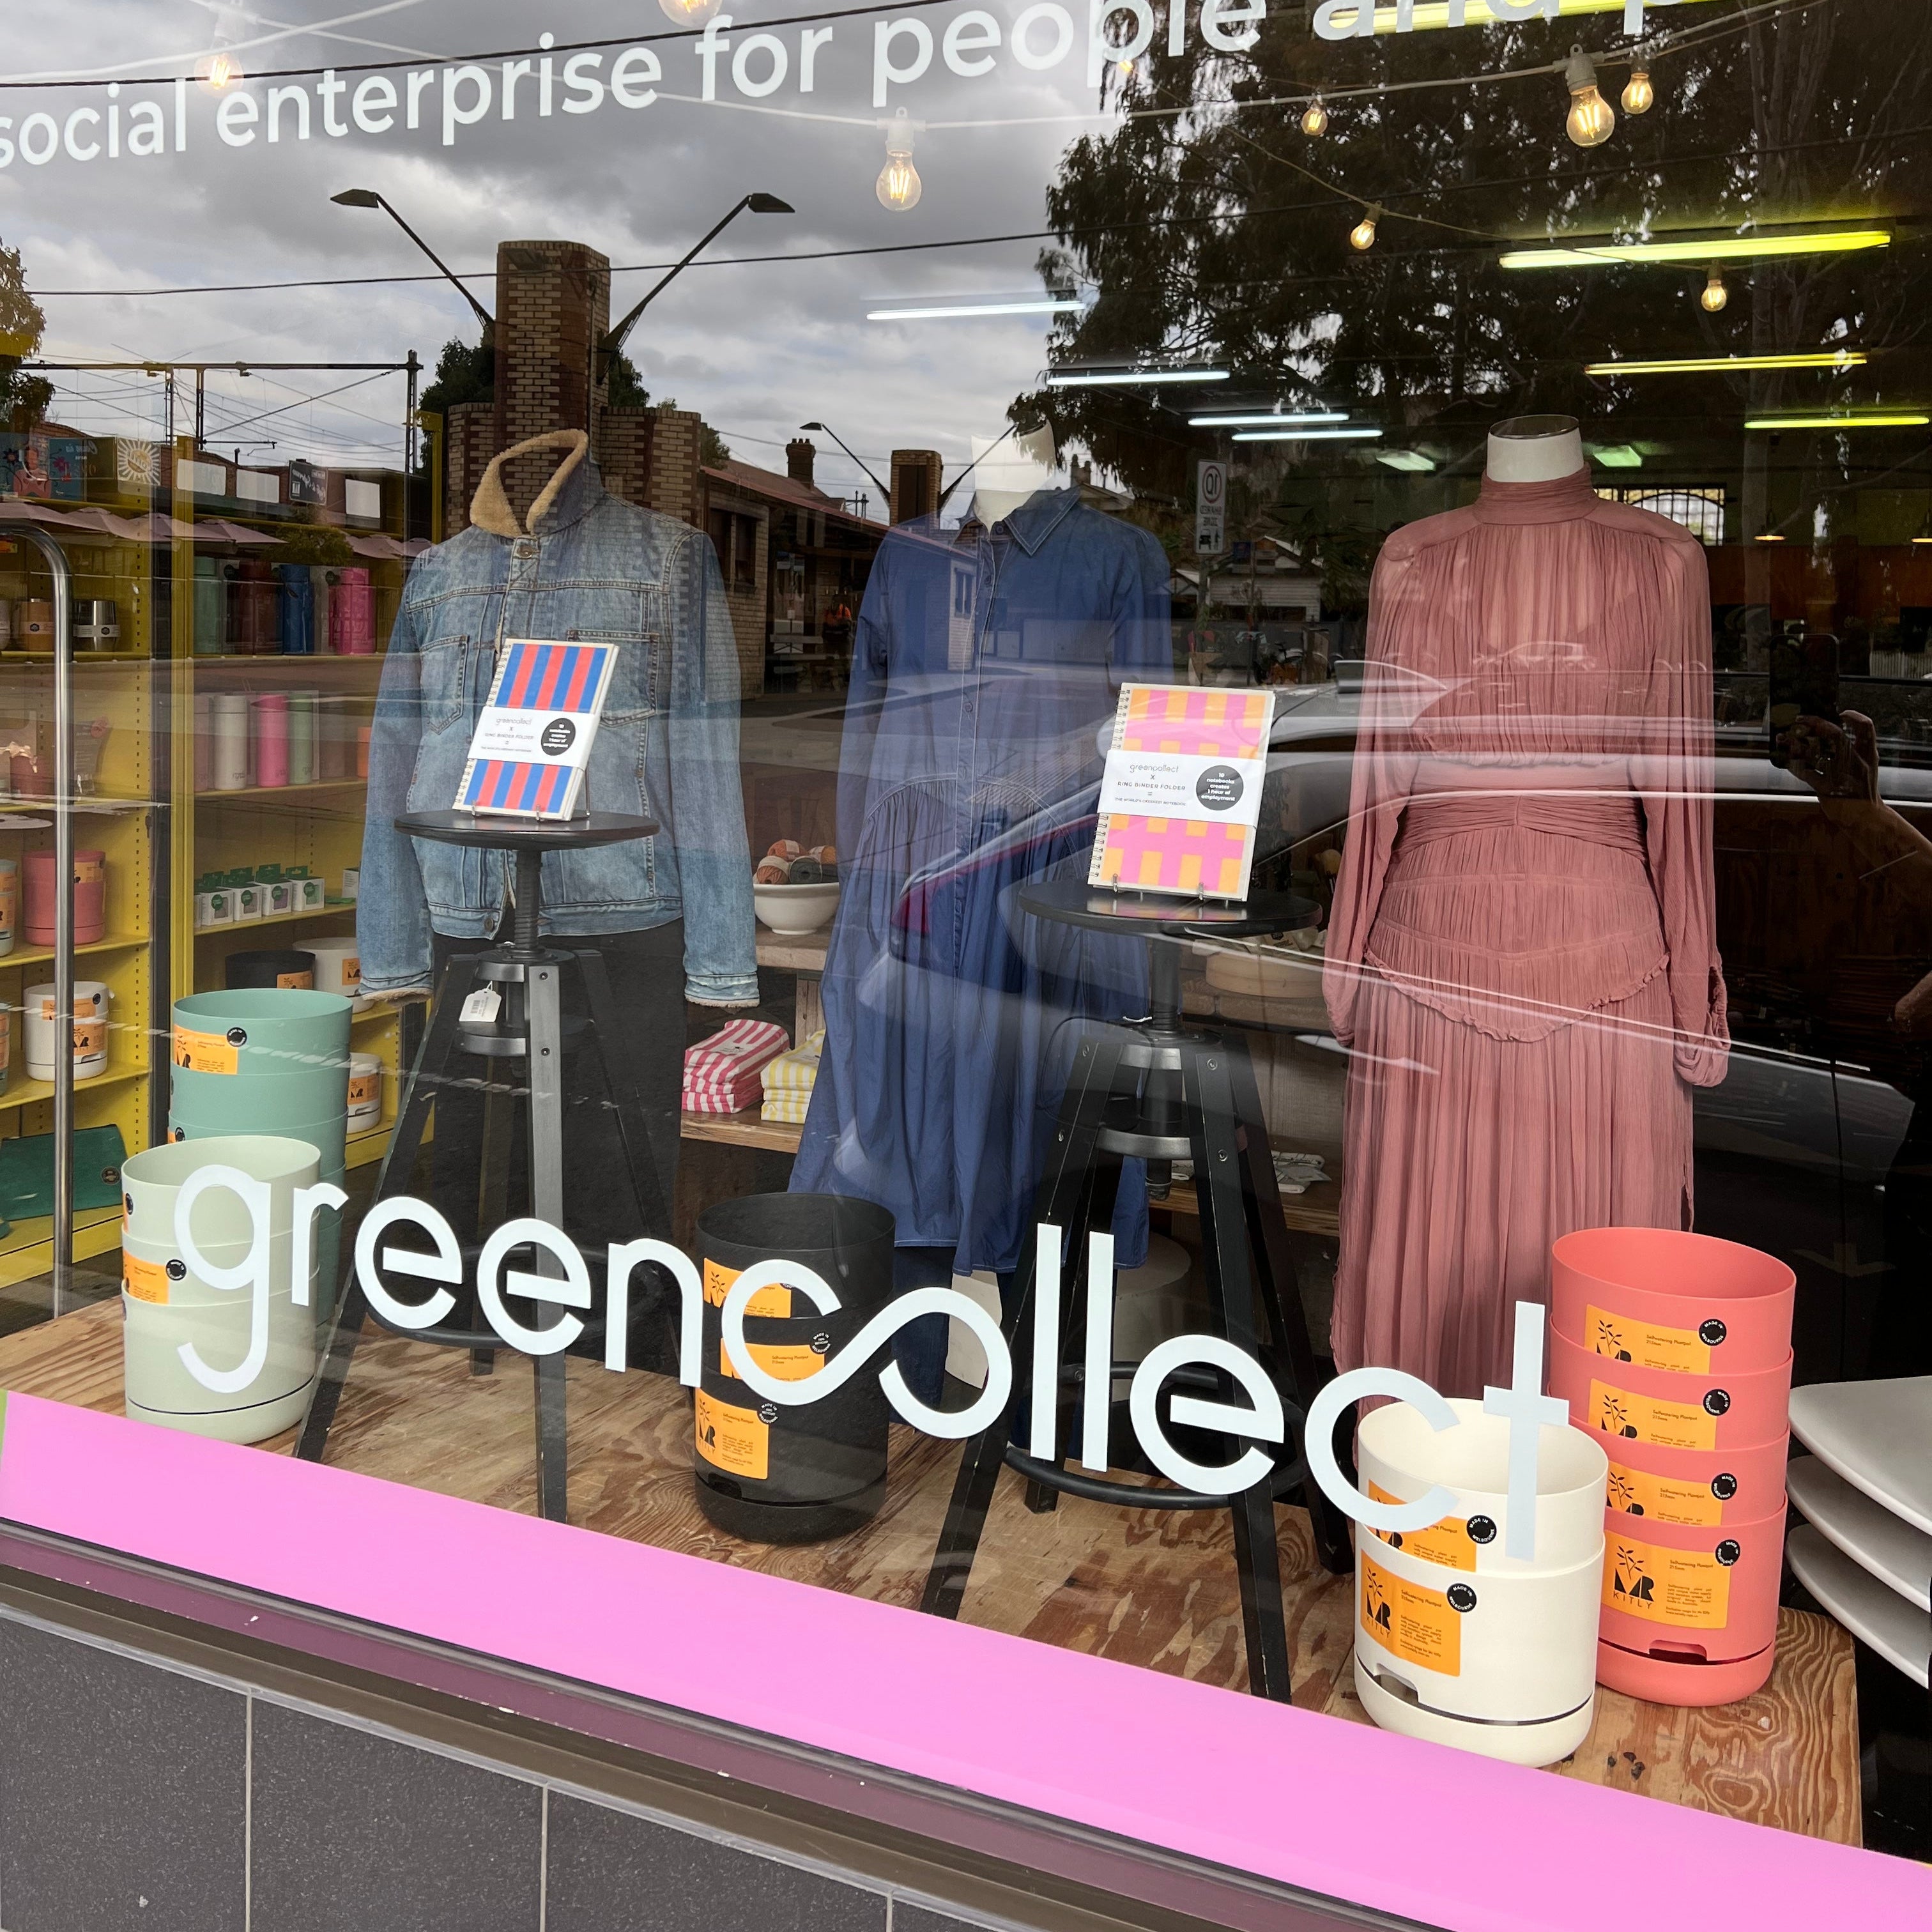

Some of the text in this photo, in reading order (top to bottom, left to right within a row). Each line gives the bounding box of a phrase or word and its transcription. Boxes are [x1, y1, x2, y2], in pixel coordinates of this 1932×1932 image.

[217, 32, 662, 147] enterprise
[695, 14, 832, 102] for
[873, 0, 1266, 108] people
[1130, 764, 1179, 773] greencollect
[1646, 1334, 1673, 1344] Selfwatering
[1701, 1333, 1724, 1344] MELBOURNE
[174, 1165, 1571, 1560] greencollect
[1652, 1409, 1678, 1420] Selfwatering
[1660, 1487, 1686, 1498] Selfwatering
[1469, 1517, 1481, 1528] MADE
[1613, 1591, 1653, 1609] KITLY
[1366, 1616, 1392, 1638] KITLY
